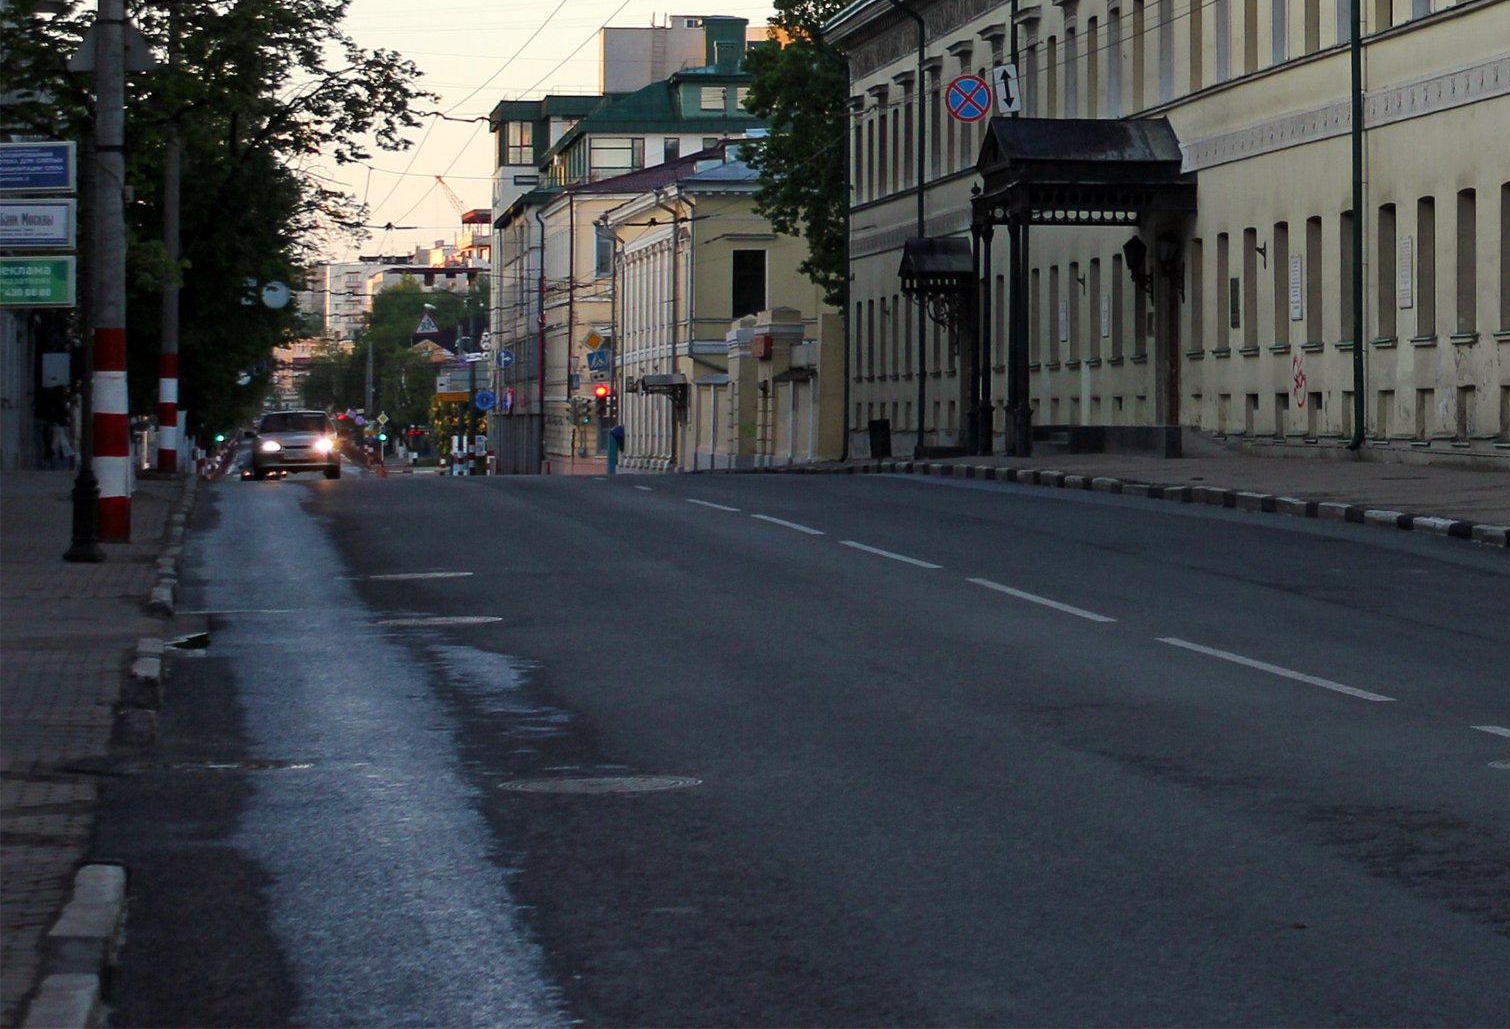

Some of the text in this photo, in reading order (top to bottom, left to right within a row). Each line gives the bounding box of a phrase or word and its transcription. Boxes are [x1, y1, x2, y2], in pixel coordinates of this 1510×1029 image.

[1, 213, 54, 226] Банк Москвы
[0, 266, 52, 275] еклама
